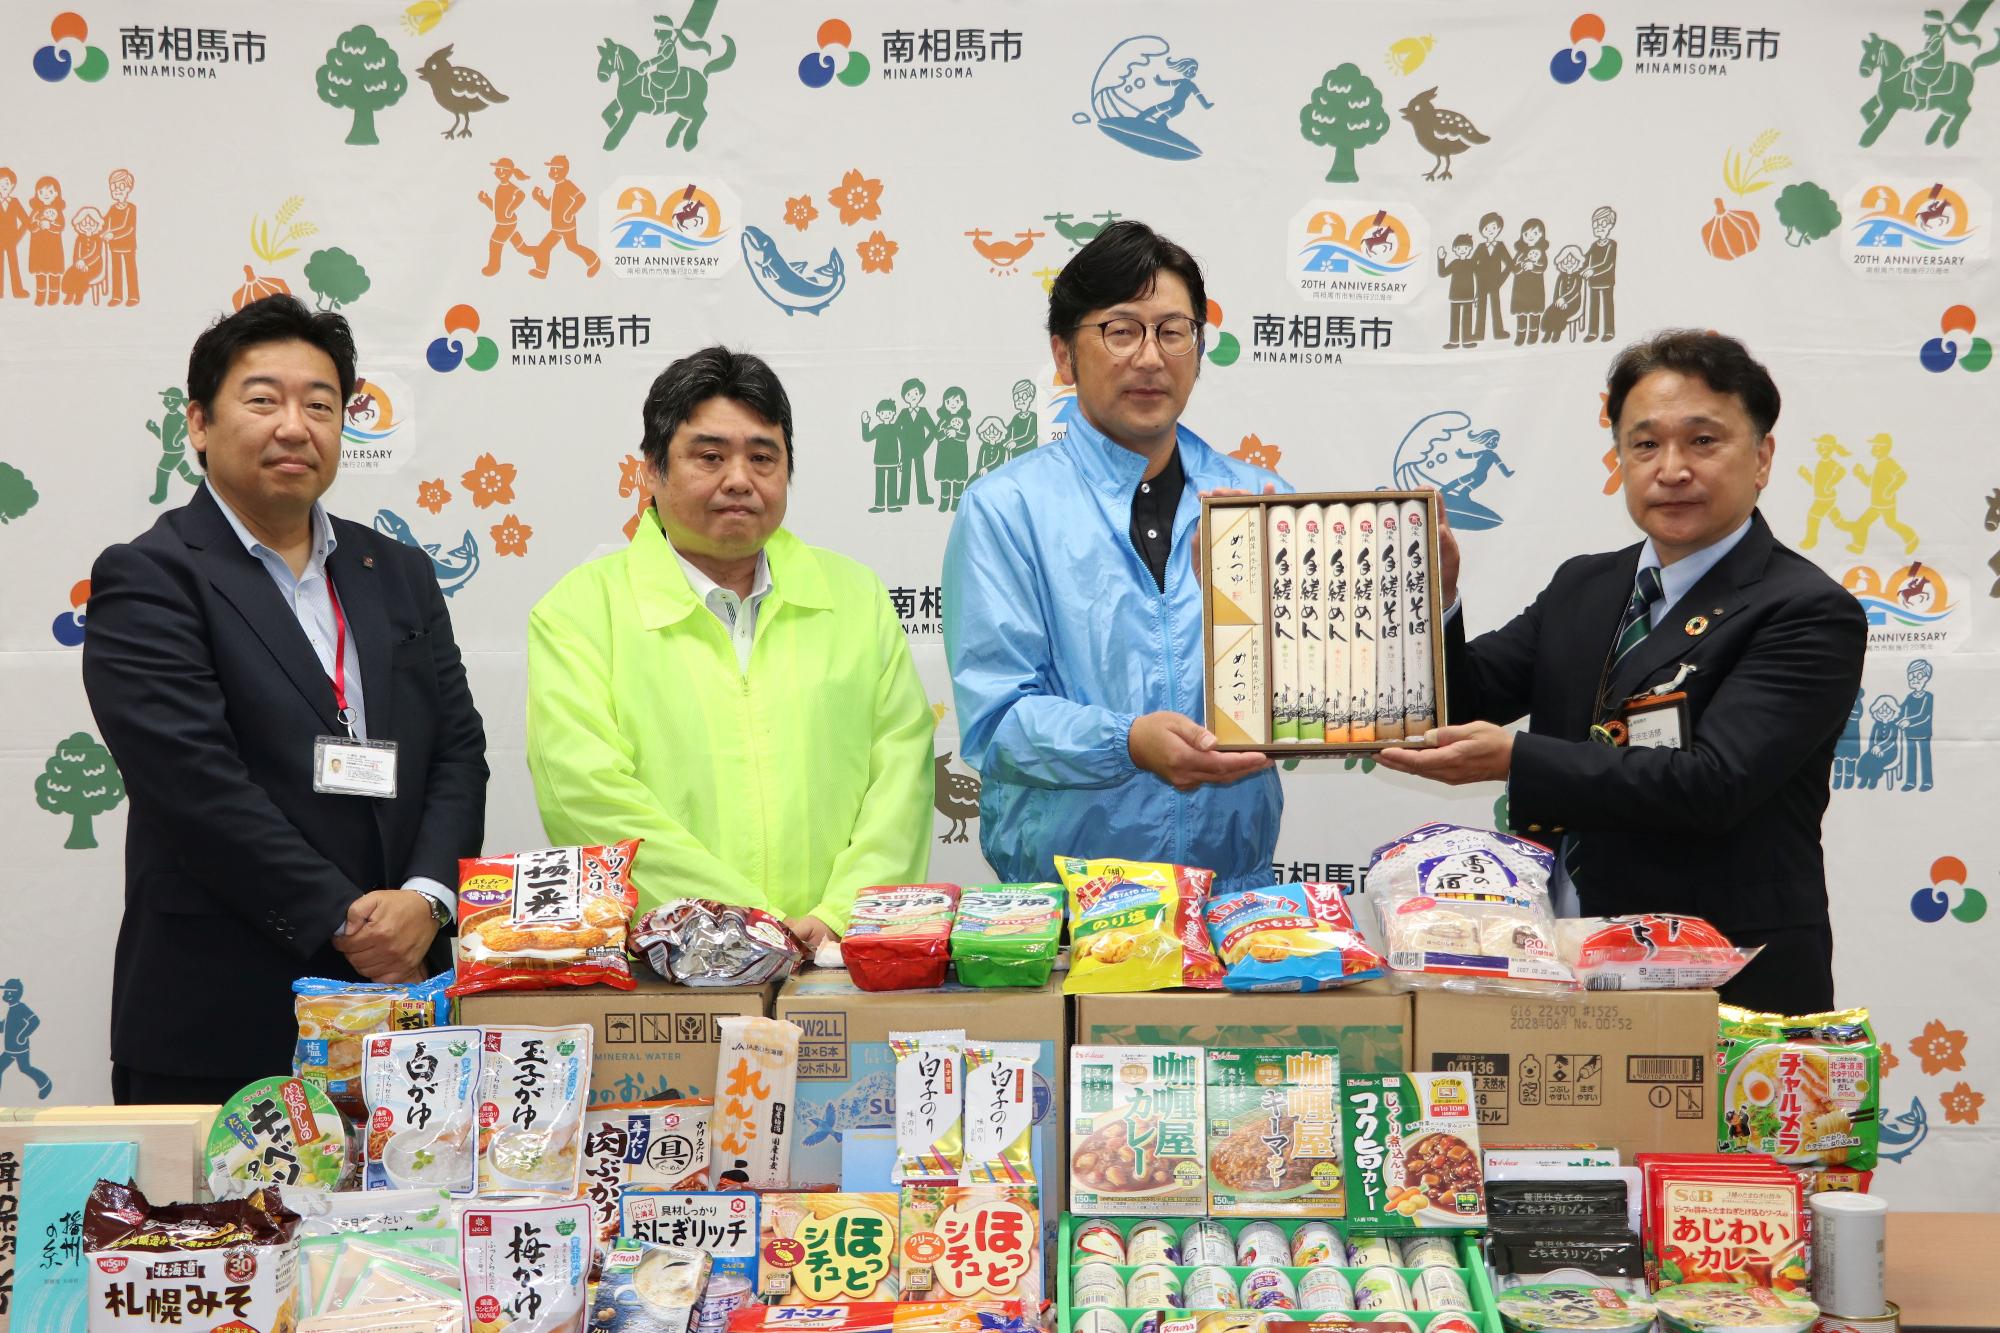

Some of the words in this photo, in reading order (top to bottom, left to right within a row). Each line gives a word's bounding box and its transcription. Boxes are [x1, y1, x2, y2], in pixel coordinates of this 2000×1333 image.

[119, 25, 267, 65] 南相馬市
[881, 28, 1023, 64] 南相馬市
[1635, 23, 1780, 61] 南相馬市
[122, 65, 218, 79] MINAMISOMA
[883, 67, 973, 79] MINAMISOMA
[1635, 62, 1727, 76] MINAMISOMA
[615, 256, 639, 265] 20TH
[645, 256, 720, 266] ANNIVERSARY
[1854, 255, 1879, 264] 20TH
[1884, 256, 1965, 265] ANNIVERSARY
[1301, 280, 1326, 289] 20TH
[1331, 280, 1407, 292] ANNIVERSARY
[510, 314, 651, 351] 南相馬市
[1252, 313, 1392, 350] 南相馬市
[512, 353, 602, 366] MINAMISOMA
[1253, 351, 1343, 365] MINAMISOMA
[1230, 534, 1244, 585] めんつゆ
[1870, 632, 1947, 642] ANNIVERSARY
[1233, 652, 1246, 703] めんつゆ
[467, 891, 507, 901] 醤油味
[855, 897, 945, 909] うす焼
[964, 897, 1050, 908] うす焼
[1092, 909, 1148, 931] のり塩
[1224, 918, 1315, 948] じゃがいもと塩
[403, 1002, 425, 1010] 明星
[1511, 1006, 1532, 1017] G16
[1539, 1006, 1575, 1017] 22490
[1583, 1006, 1618, 1017] #1525
[306, 1042, 321, 1057] 塩
[594, 1052, 641, 1061] MINERAL
[1447, 1061, 1495, 1074] 041136
[1830, 1062, 1864, 1070] 北海道産
[406, 1041, 438, 1130] 白がゆ
[512, 1040, 549, 1130] 玉子がゆ
[1482, 1077, 1506, 1090] 天然水
[1549, 1085, 1570, 1093] つぶし
[1580, 1085, 1594, 1093] 注ぎ
[919, 1051, 941, 1135] 白子のり
[1577, 1094, 1599, 1102] やすい
[721, 1057, 771, 1155] れんこん
[990, 1062, 1013, 1141] 白子のり
[1779, 1054, 1802, 1155] チャルメラ
[285, 1083, 313, 1140] 懐かしの
[1124, 1087, 1157, 1176] カレー
[1261, 1089, 1289, 1188] キーマカレー
[1385, 1091, 1405, 1180] じっくり煮込んだ
[630, 1120, 648, 1159] 牛だし
[696, 1121, 707, 1163] かけるだけ
[1762, 1139, 1775, 1153] 塩
[652, 1139, 688, 1166] 具
[585, 1122, 628, 1224] 肉ぶっかけ
[1524, 1192, 1584, 1202] 贅沢仕立ての
[1674, 1188, 1713, 1203] S&B
[661, 1205, 717, 1217] 具材しっかり
[1517, 1204, 1595, 1215] ごちそうリゾット
[338, 1216, 403, 1227] 日たい
[1672, 1215, 1790, 1245] あじわい
[40, 1223, 62, 1270] の糸
[772, 1241, 798, 1249] コーン
[910, 1234, 941, 1247] クリーム
[834, 1216, 884, 1291] ほっと
[944, 1220, 983, 1289] シチュー
[974, 1209, 1024, 1288] ほっと
[1529, 1249, 1607, 1261] ごちそうリゾット
[231, 1259, 251, 1272] 30
[610, 1252, 641, 1264] Knorr
[804, 1227, 842, 1293] シチュー
[1697, 1246, 1770, 1271] カレー
[153, 1261, 199, 1277] 北海道
[504, 1222, 551, 1320] 梅がゆ
[105, 1281, 253, 1324] 札幌みそ
[776, 1307, 842, 1320] オーマイ
[1162, 1319, 1195, 1333] Knorr
